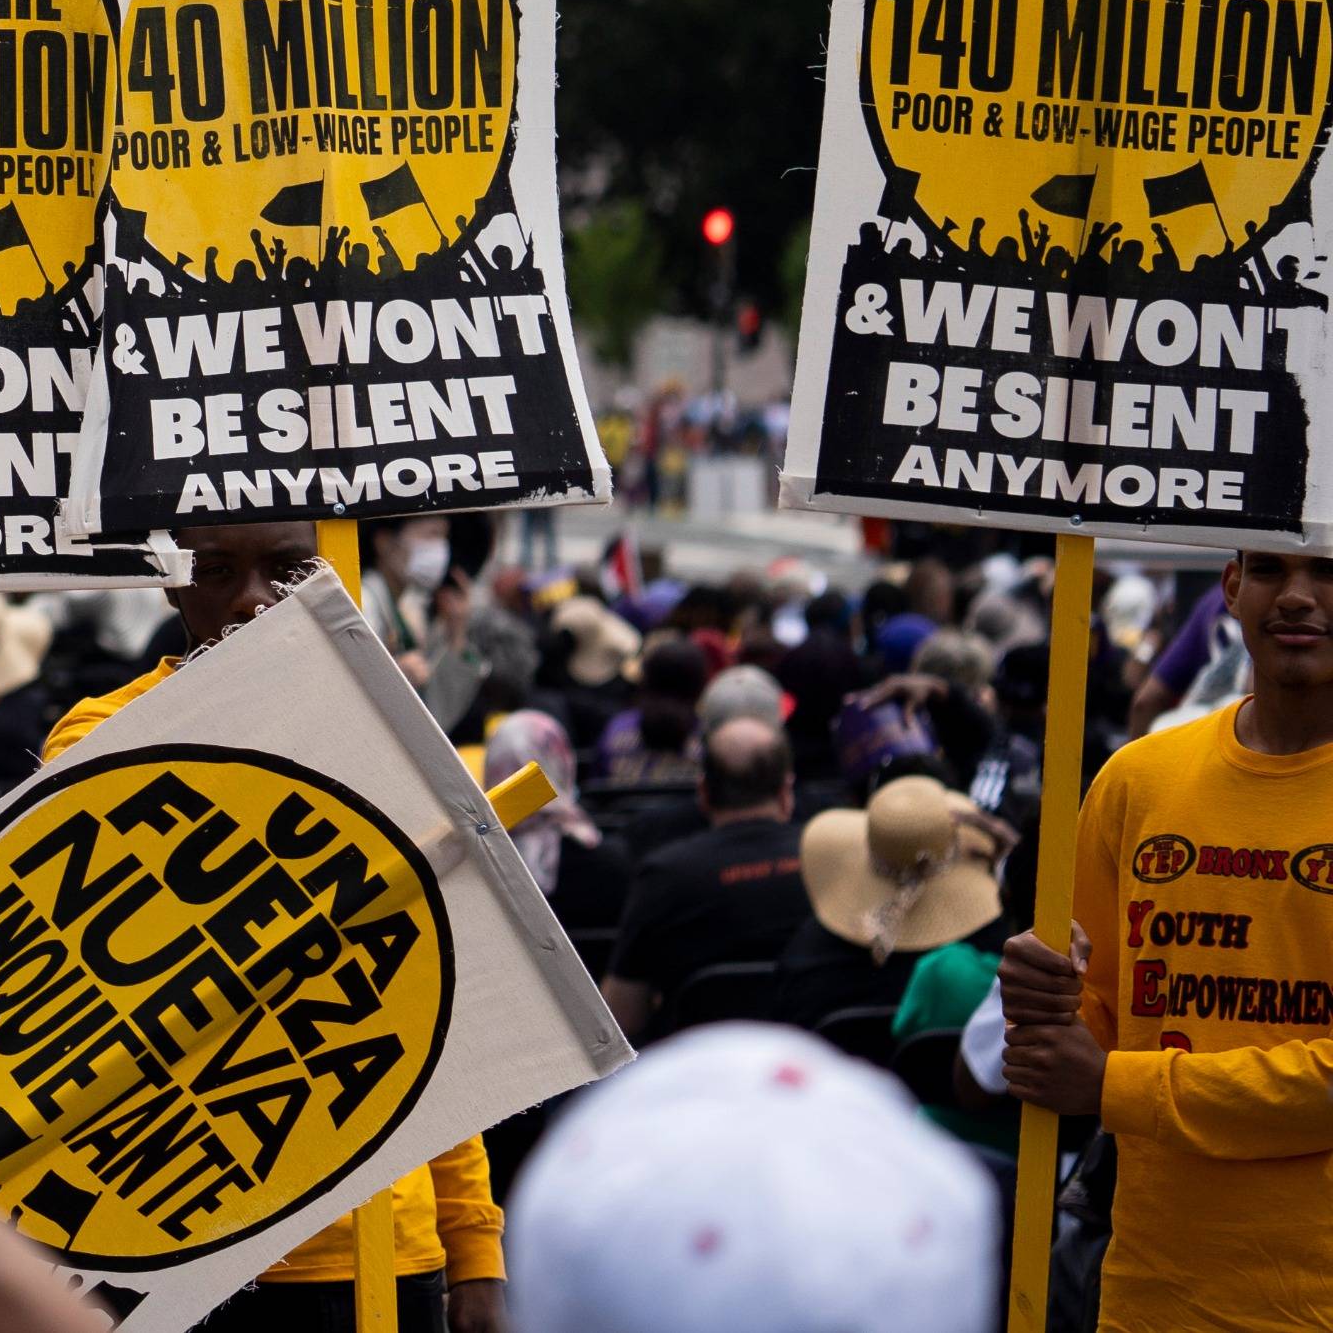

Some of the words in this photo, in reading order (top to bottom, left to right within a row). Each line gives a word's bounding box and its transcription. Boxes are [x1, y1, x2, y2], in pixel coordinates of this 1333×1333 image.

[113, 131, 191, 171] POOR
[202, 129, 221, 165] &
[234, 116, 382, 163] LOW-WAGE
[391, 114, 494, 158] PEOPLE
[891, 91, 971, 135] POOR
[982, 100, 1003, 138] &
[1014, 101, 1177, 155] LOW-WAGE
[1187, 112, 1300, 159] PEOPLE
[294, 295, 551, 368] WON'T
[149, 394, 247, 461] BE
[258, 376, 517, 455] SILENT
[882, 361, 980, 431] BE
[991, 372, 1268, 456] SILENT
[175, 450, 520, 515] ANYMORE
[891, 445, 1244, 512] ANYMORE
[265, 791, 421, 995] UNA
[1140, 850, 1185, 874] YEP
[1196, 846, 1289, 880] BRONX
[104, 770, 406, 1131] FUERZA
[1127, 900, 1252, 949] YOUTH
[9, 809, 312, 1184] NUEVA
[1131, 959, 1333, 1025] EMPOWERMEN
